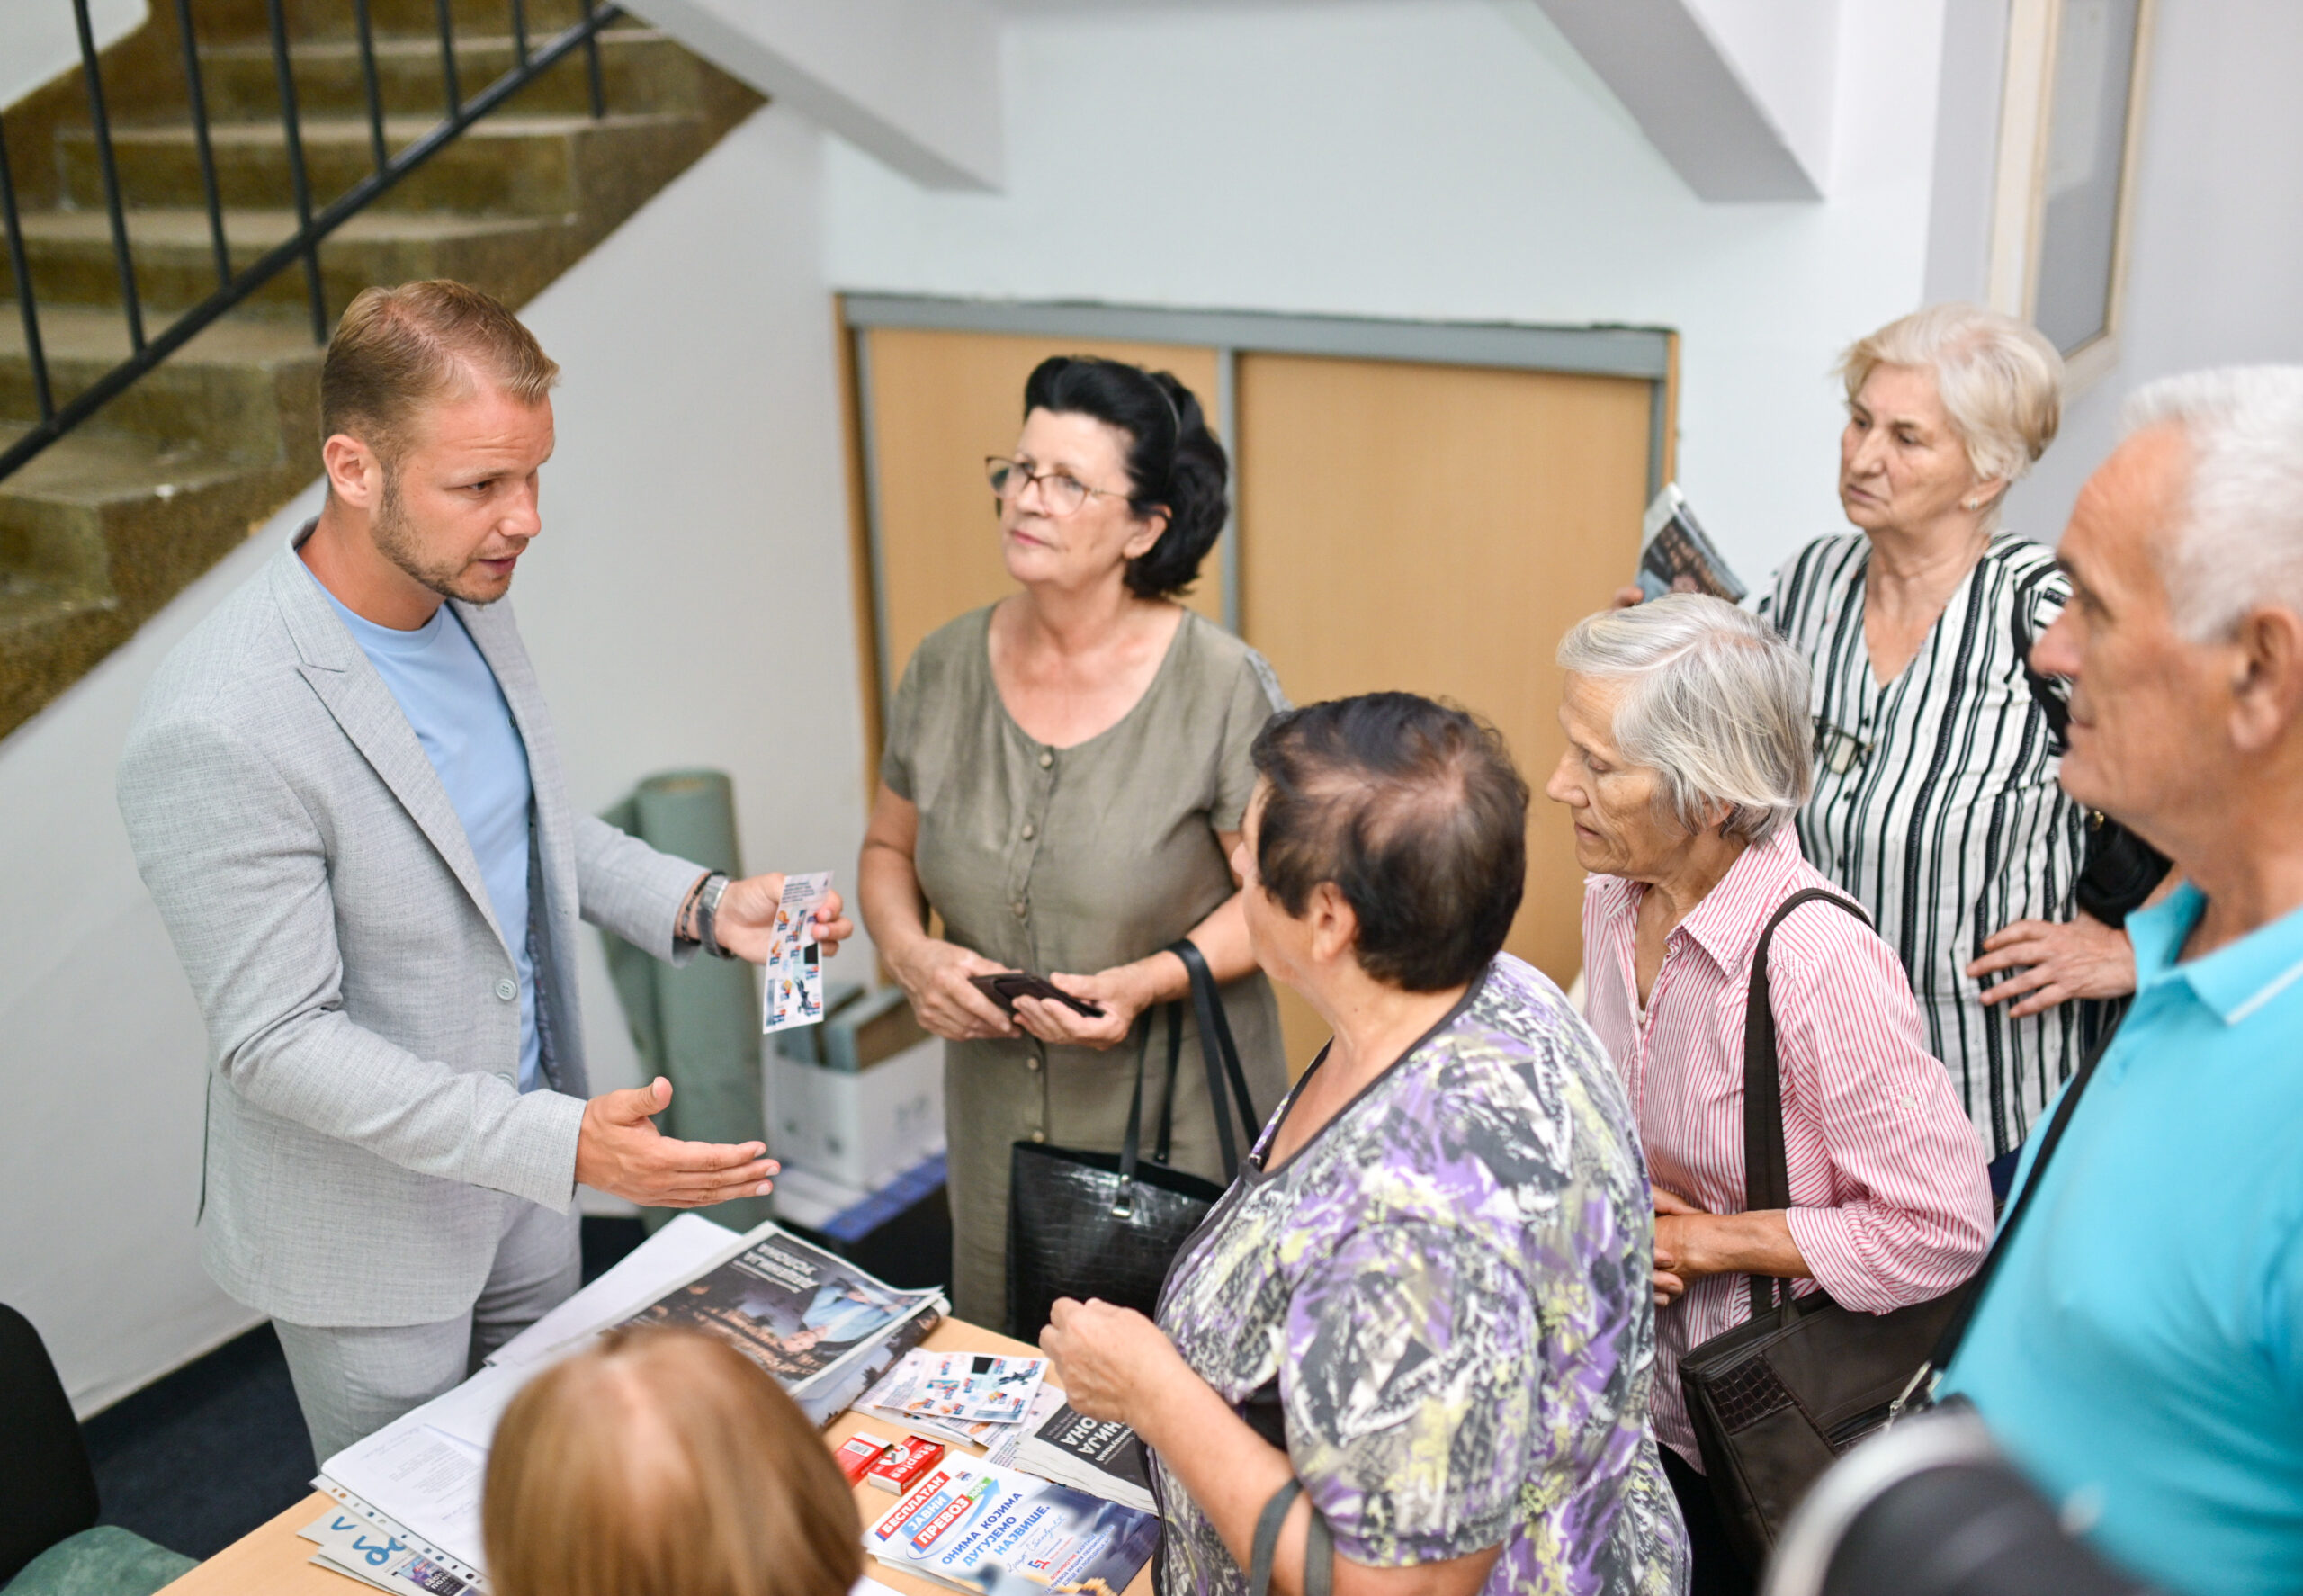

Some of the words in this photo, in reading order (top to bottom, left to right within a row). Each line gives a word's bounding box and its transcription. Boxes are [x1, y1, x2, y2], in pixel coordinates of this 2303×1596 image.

[890, 1443, 936, 1479] Staples
[1077, 1421, 1125, 1455] НИЈА
[880, 1476, 945, 1535] БЕСПЛАТАН
[907, 1494, 947, 1531] ЈАВНИ
[918, 1497, 970, 1545] ПРЕВОЗ
[941, 1531, 981, 1565] ОНИМА
[981, 1493, 1023, 1529] КОЈИМА
[993, 1504, 1051, 1556] НАЈВИШЕ.
[963, 1516, 1017, 1567] ДУГУЈЕМО
